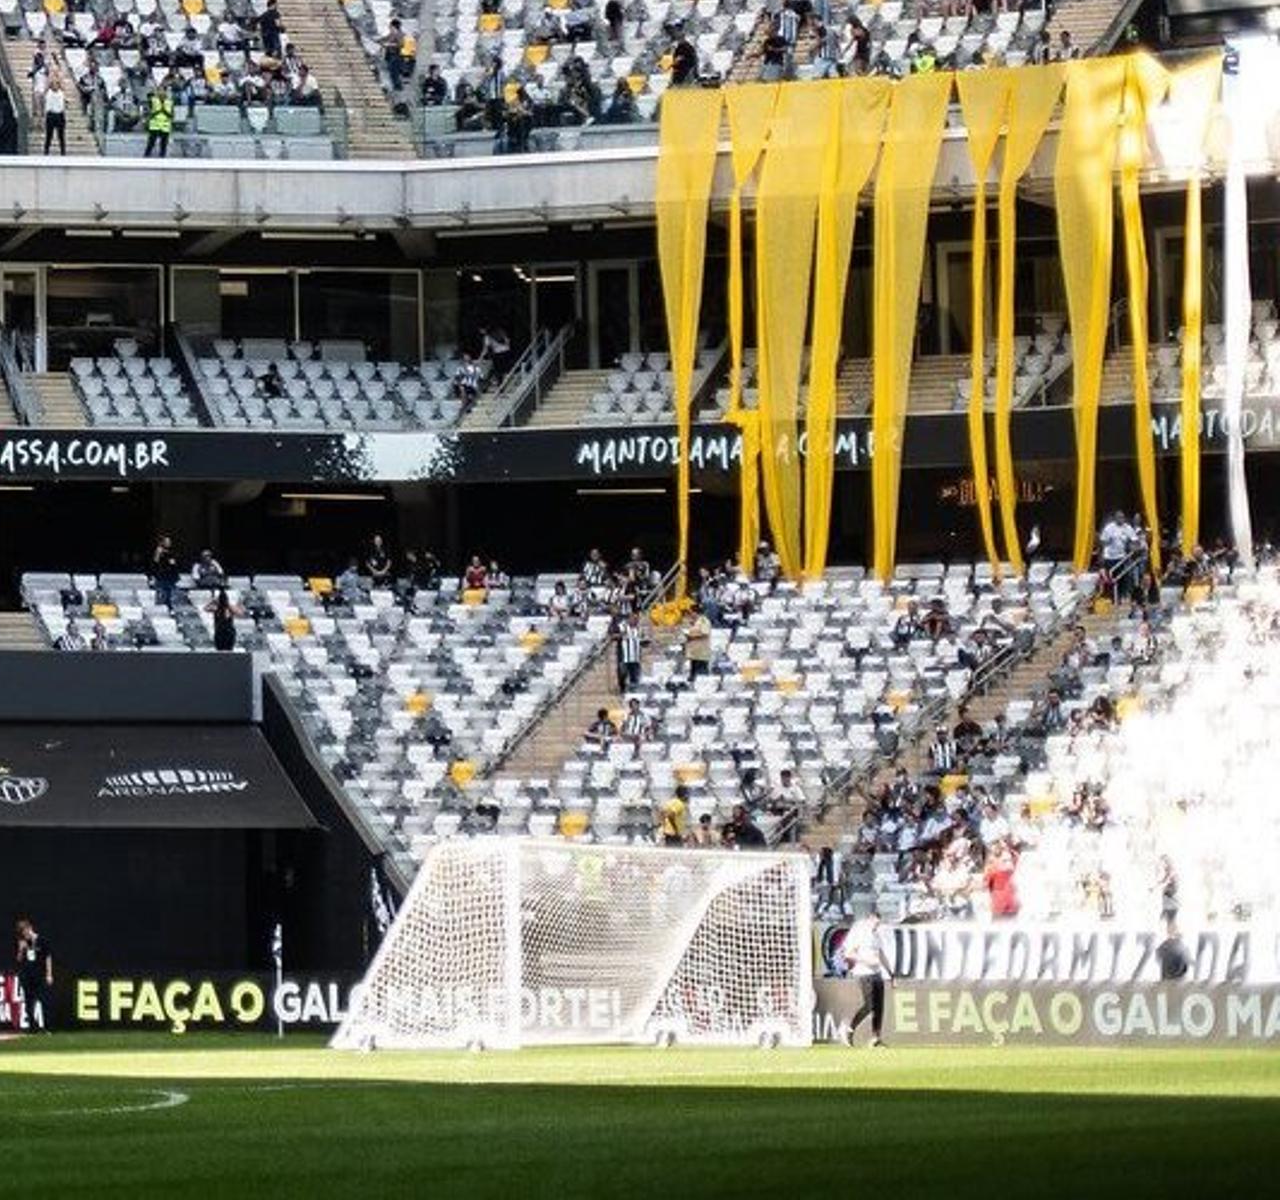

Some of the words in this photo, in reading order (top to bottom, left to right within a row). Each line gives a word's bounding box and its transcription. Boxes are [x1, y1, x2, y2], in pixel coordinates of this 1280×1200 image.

[895, 929, 1251, 982] UNIFORMIZDA
[77, 981, 101, 1021] E
[110, 981, 227, 1034] FAÇA
[231, 982, 264, 1022] O
[894, 992, 920, 1034] E
[929, 992, 1042, 1046] FAÇA
[1050, 992, 1083, 1036] O
[1093, 993, 1216, 1037] GALO
